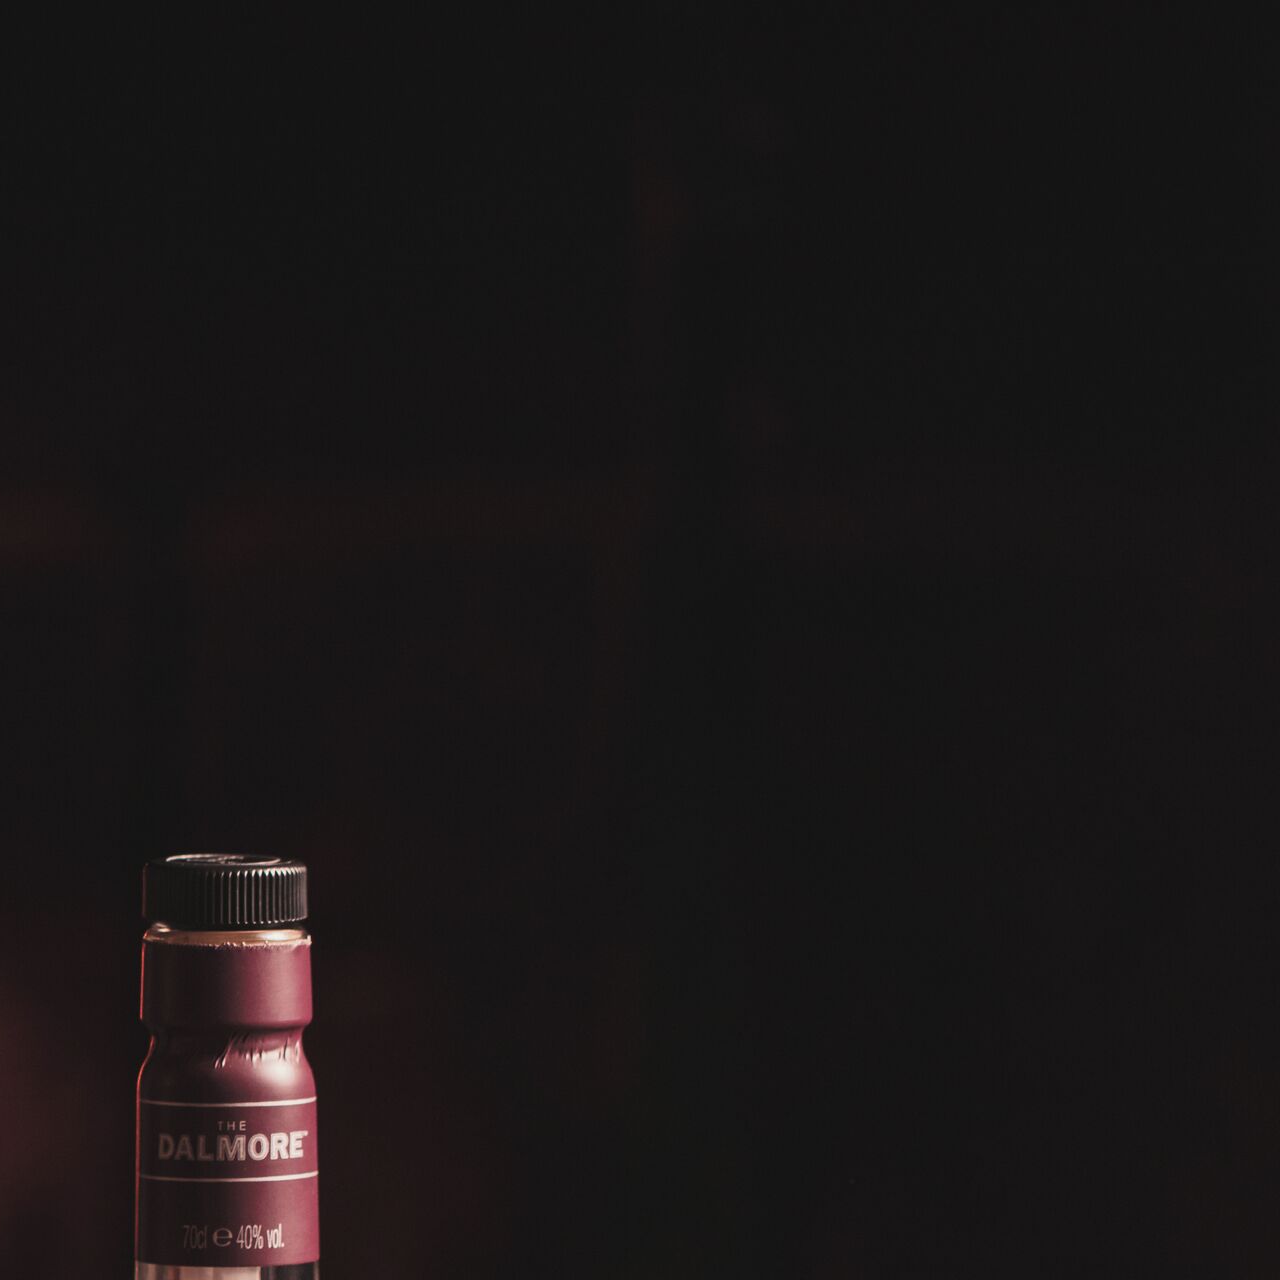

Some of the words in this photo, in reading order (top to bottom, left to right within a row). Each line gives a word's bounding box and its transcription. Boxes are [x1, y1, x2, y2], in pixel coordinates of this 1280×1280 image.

[217, 1120, 247, 1131] THE
[183, 1224, 207, 1249] 70cl
[236, 1224, 264, 1250] 40%
[266, 1223, 286, 1249] vol.
